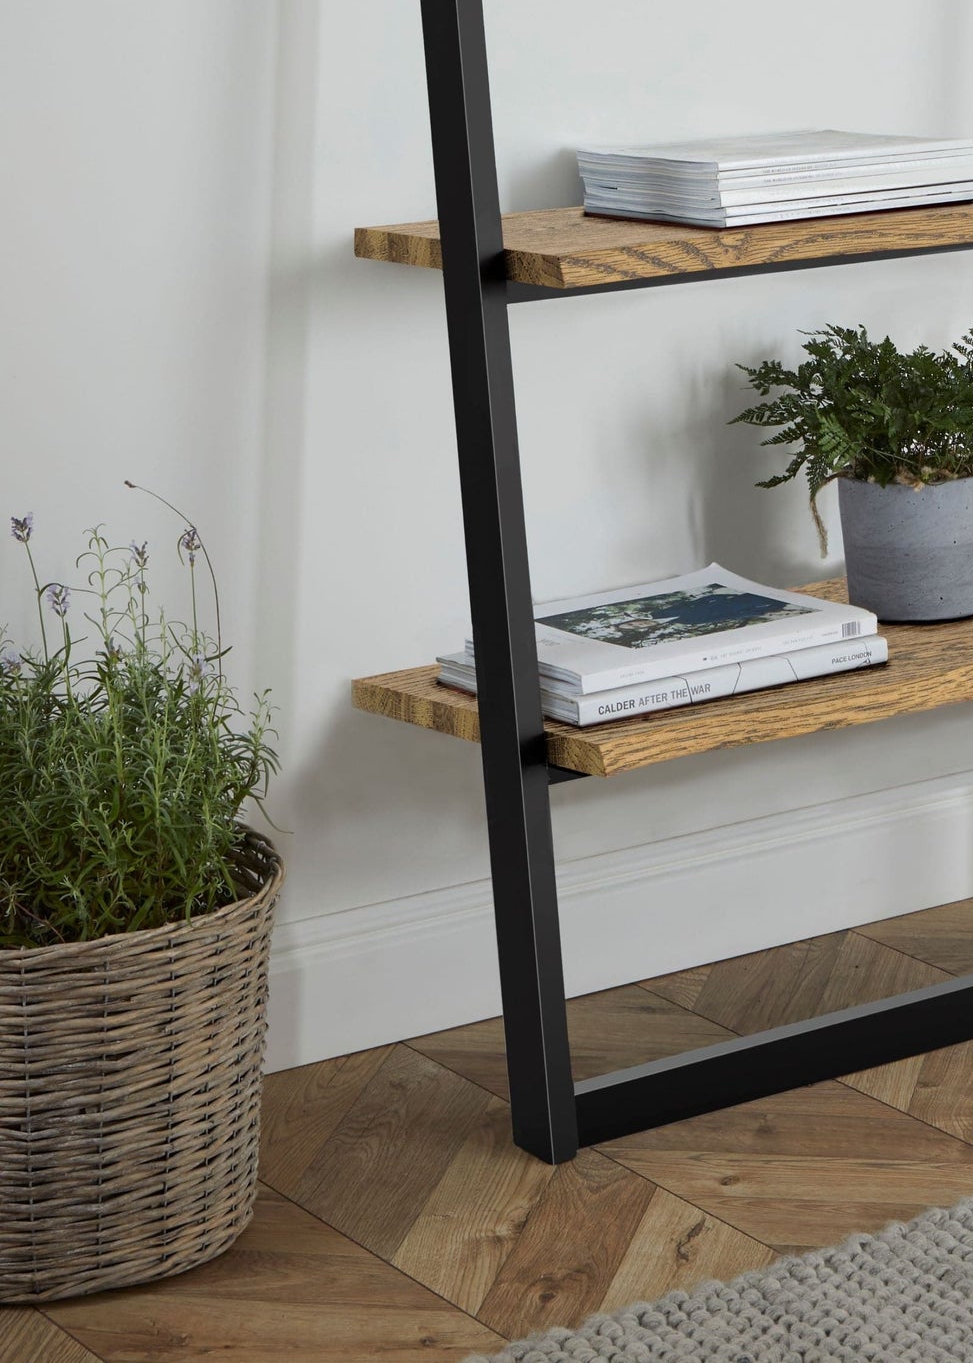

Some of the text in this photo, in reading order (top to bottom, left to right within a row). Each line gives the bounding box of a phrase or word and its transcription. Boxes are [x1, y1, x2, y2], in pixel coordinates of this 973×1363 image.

[831, 651, 872, 664] PACE LONDON
[598, 683, 711, 715] CALDER AFTER THE WAR
